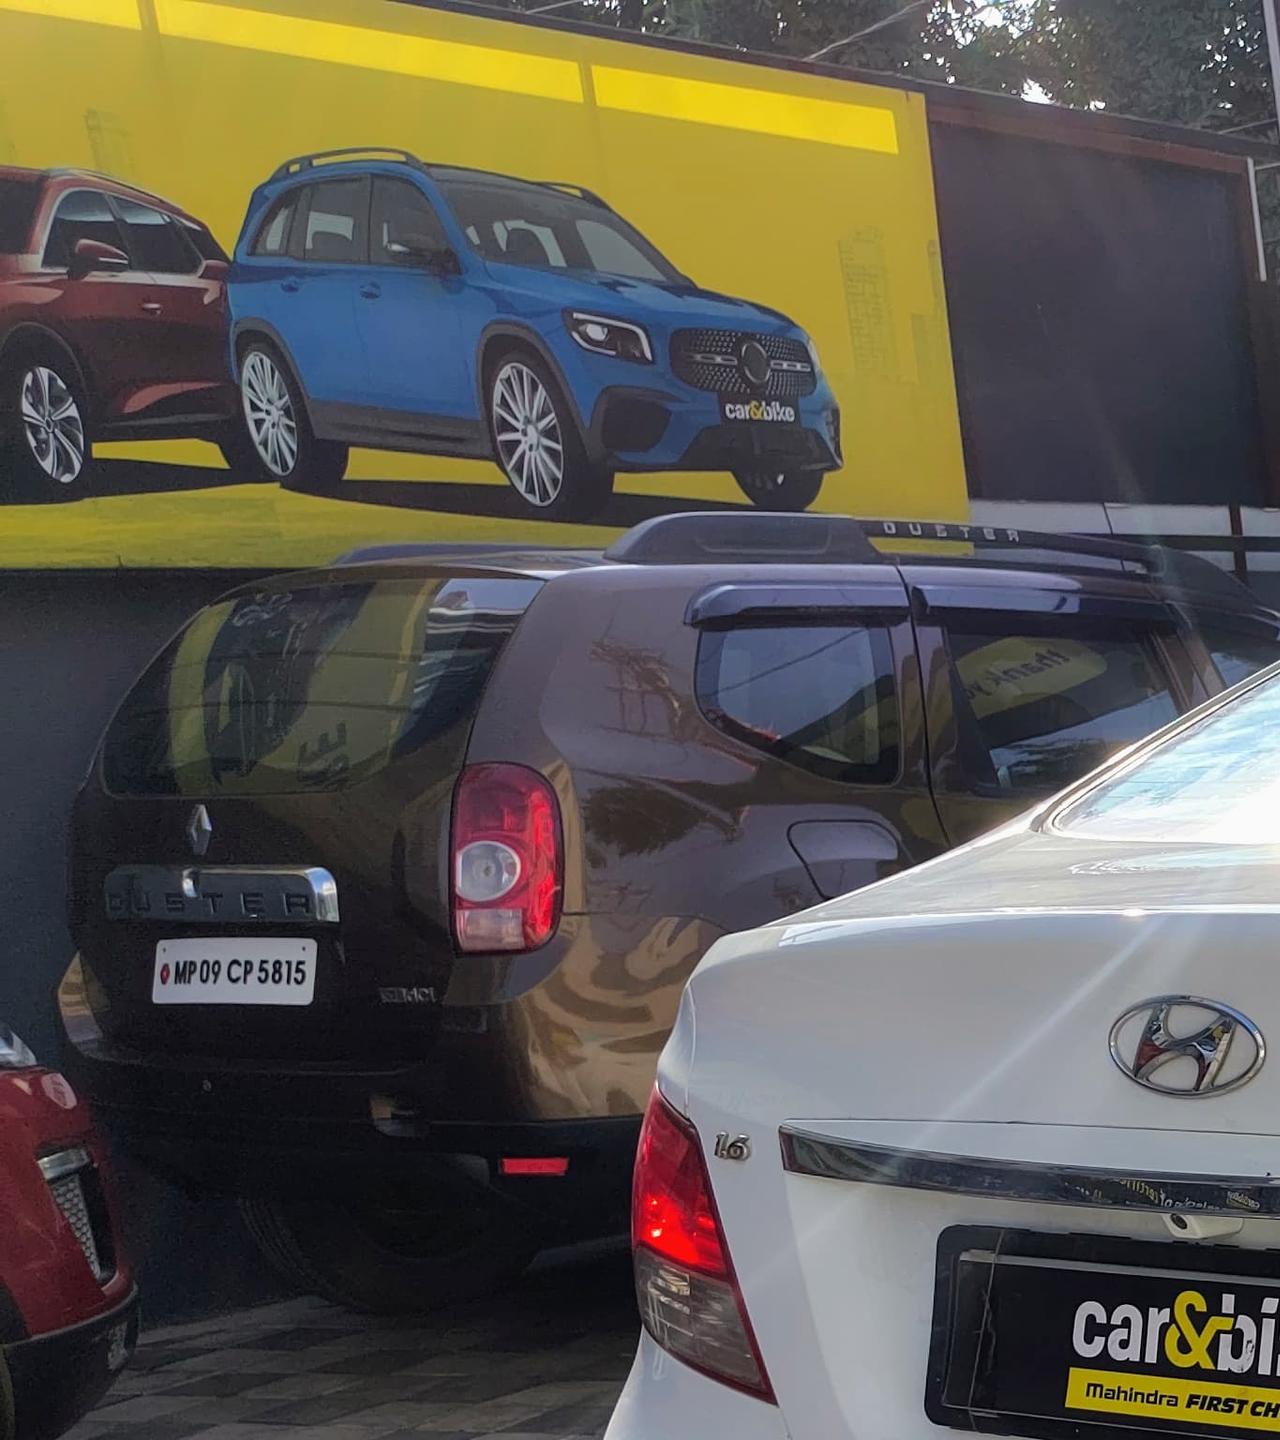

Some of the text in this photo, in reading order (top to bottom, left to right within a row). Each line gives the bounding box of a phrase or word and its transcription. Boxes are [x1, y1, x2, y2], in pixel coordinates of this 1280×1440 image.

[725, 400, 796, 422] car&bike
[883, 521, 1019, 543] DUSTER
[257, 959, 306, 985] 5815
[1085, 1382, 1179, 1407] Mahindra
[1185, 1393, 1250, 1416] FIRST
